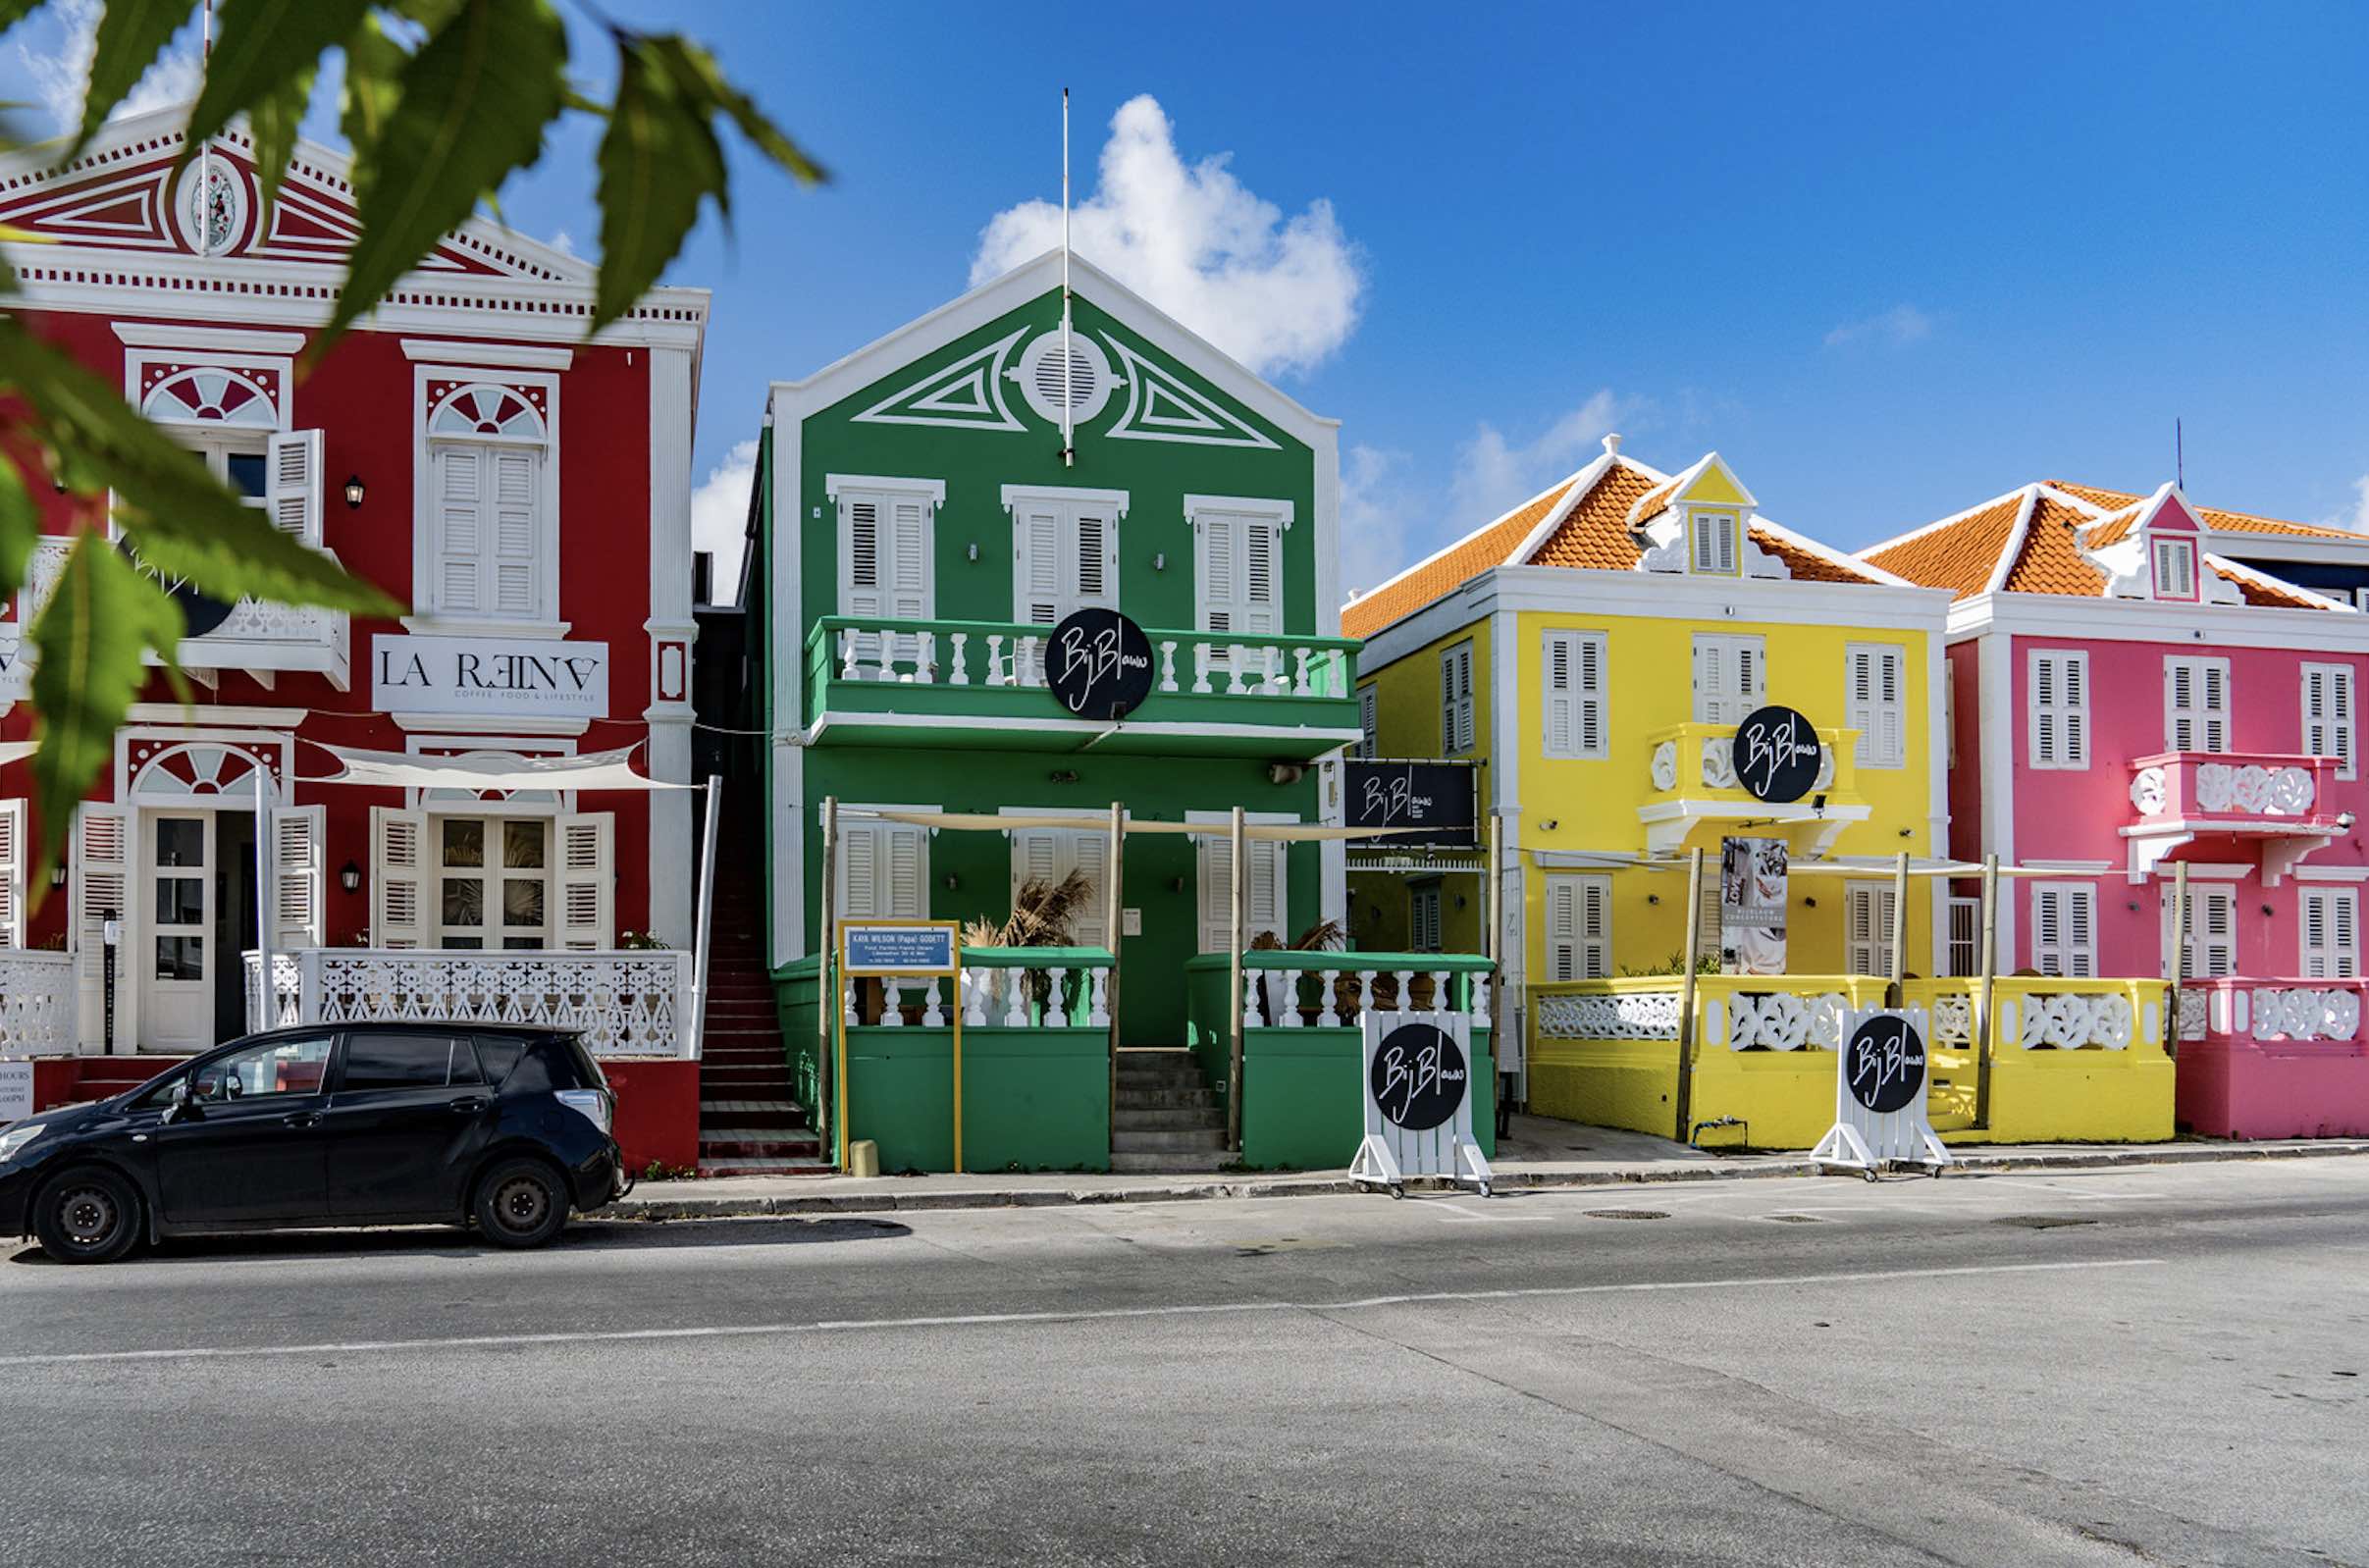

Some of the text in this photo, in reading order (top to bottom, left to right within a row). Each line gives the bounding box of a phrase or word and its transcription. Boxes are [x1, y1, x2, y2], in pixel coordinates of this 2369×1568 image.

[380, 651, 433, 687] LA
[500, 691, 530, 700] FOOD
[545, 692, 595, 703] LIFESTYLE
[870, 934, 895, 943] WILSON
